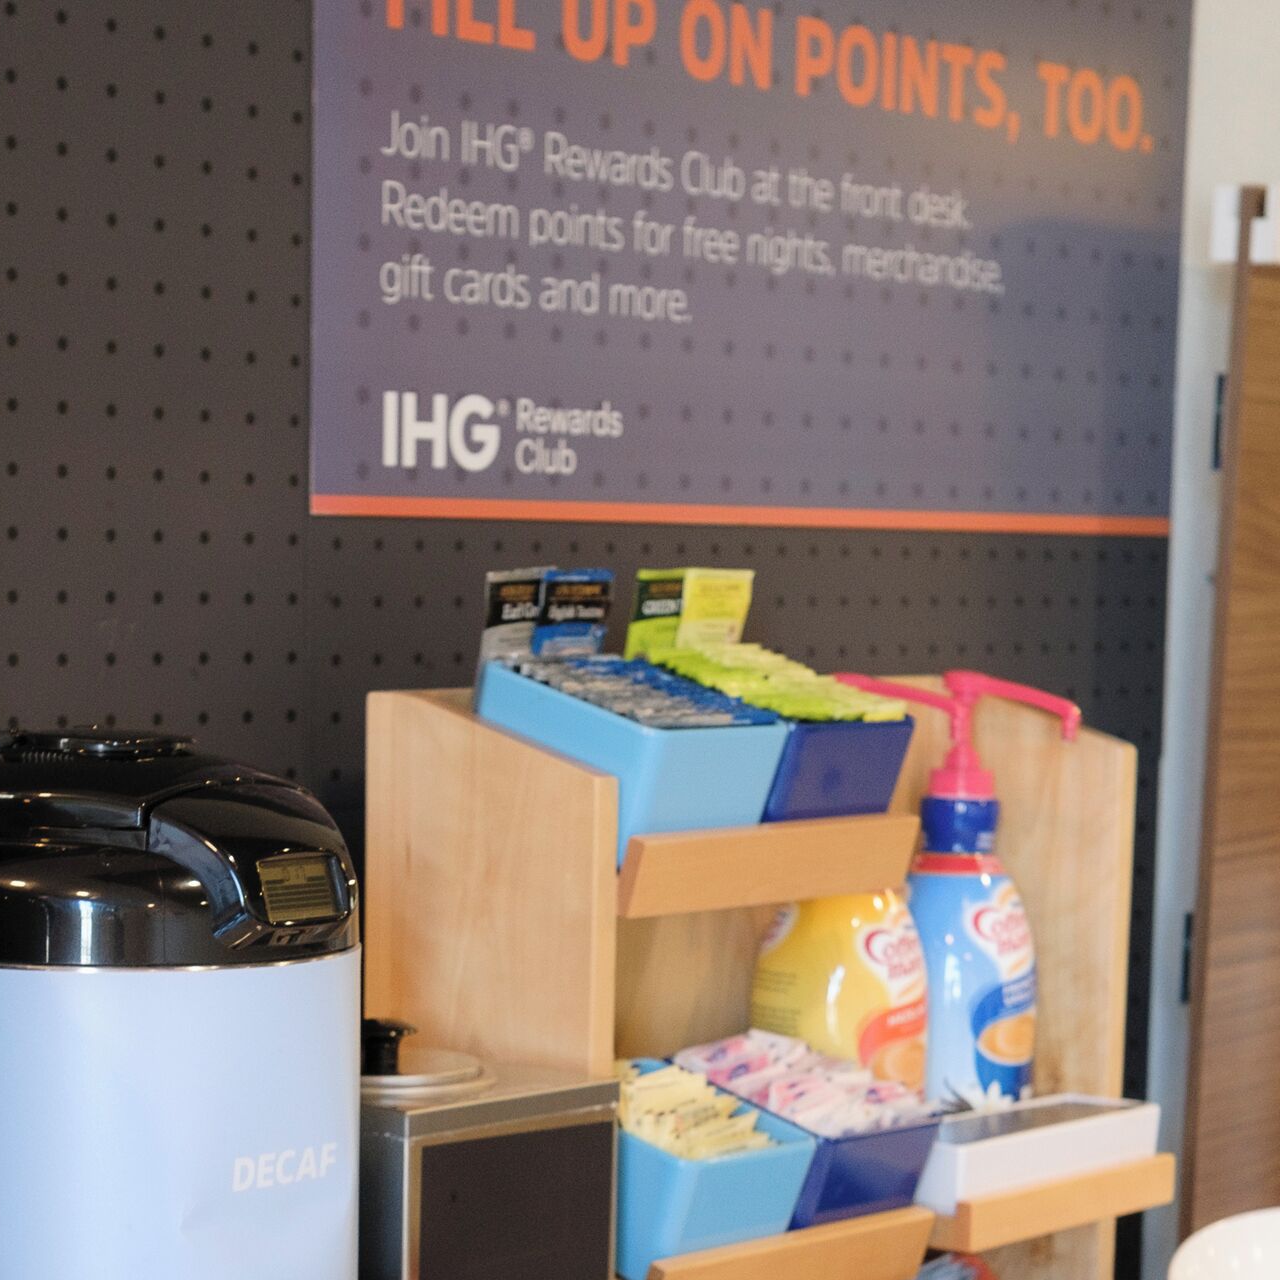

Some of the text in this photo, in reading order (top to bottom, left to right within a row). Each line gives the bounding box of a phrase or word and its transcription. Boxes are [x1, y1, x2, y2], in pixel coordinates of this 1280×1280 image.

[561, 0, 658, 68] UP
[679, 0, 774, 92] ON
[794, 15, 1021, 146] POINTS,
[1036, 60, 1155, 155] TOO.
[380, 109, 451, 161] Join
[543, 130, 675, 191] Rewards
[680, 149, 747, 202] Club
[750, 164, 782, 206] at
[787, 167, 835, 213] the
[840, 171, 904, 222] front
[907, 181, 973, 231] desk.
[380, 178, 520, 241] Redeem
[528, 202, 626, 251] points
[632, 208, 676, 257] for
[682, 215, 741, 266] free
[378, 251, 693, 325] gift cards and more.
[516, 397, 625, 438] Rewards
[515, 436, 578, 476] Club
[231, 1141, 339, 1193] DECAF
